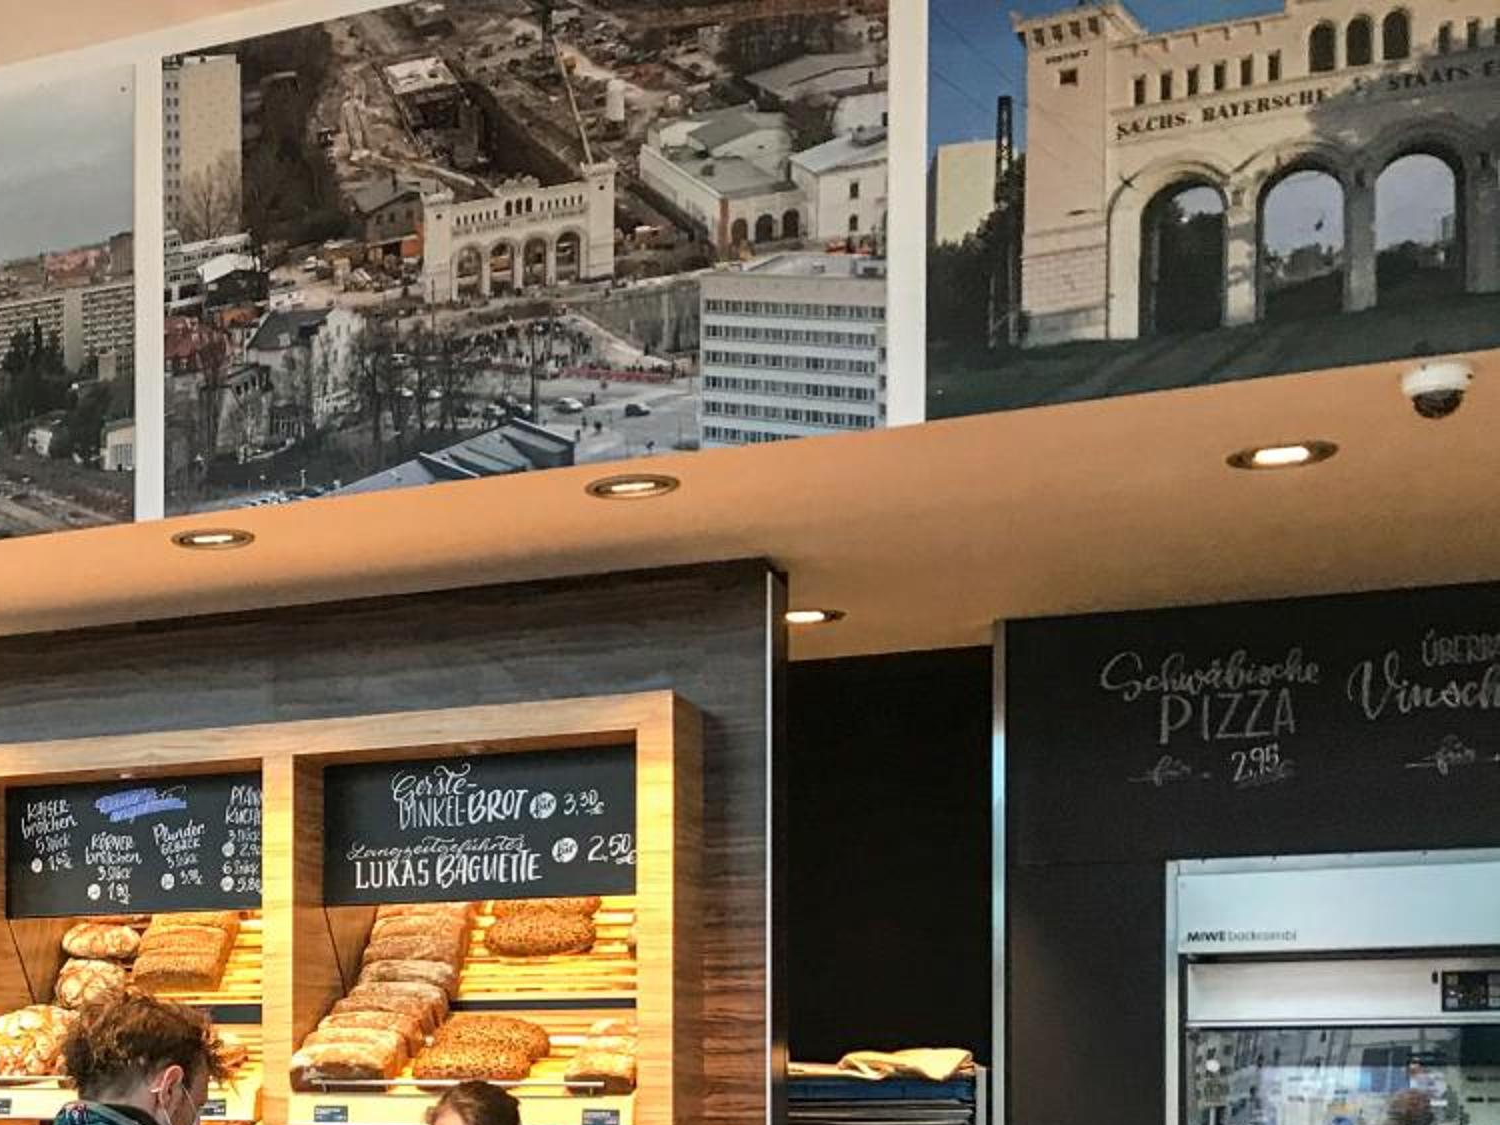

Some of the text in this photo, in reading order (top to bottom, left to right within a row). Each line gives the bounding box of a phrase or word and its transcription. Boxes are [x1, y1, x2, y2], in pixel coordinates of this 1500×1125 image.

[1100, 648, 1320, 702] Schwäbische
[1159, 687, 1296, 745] PIZZA
[355, 857, 430, 889] LUKAS
[435, 850, 543, 889] BAGUETTE
[1187, 930, 1227, 942] MIWE
